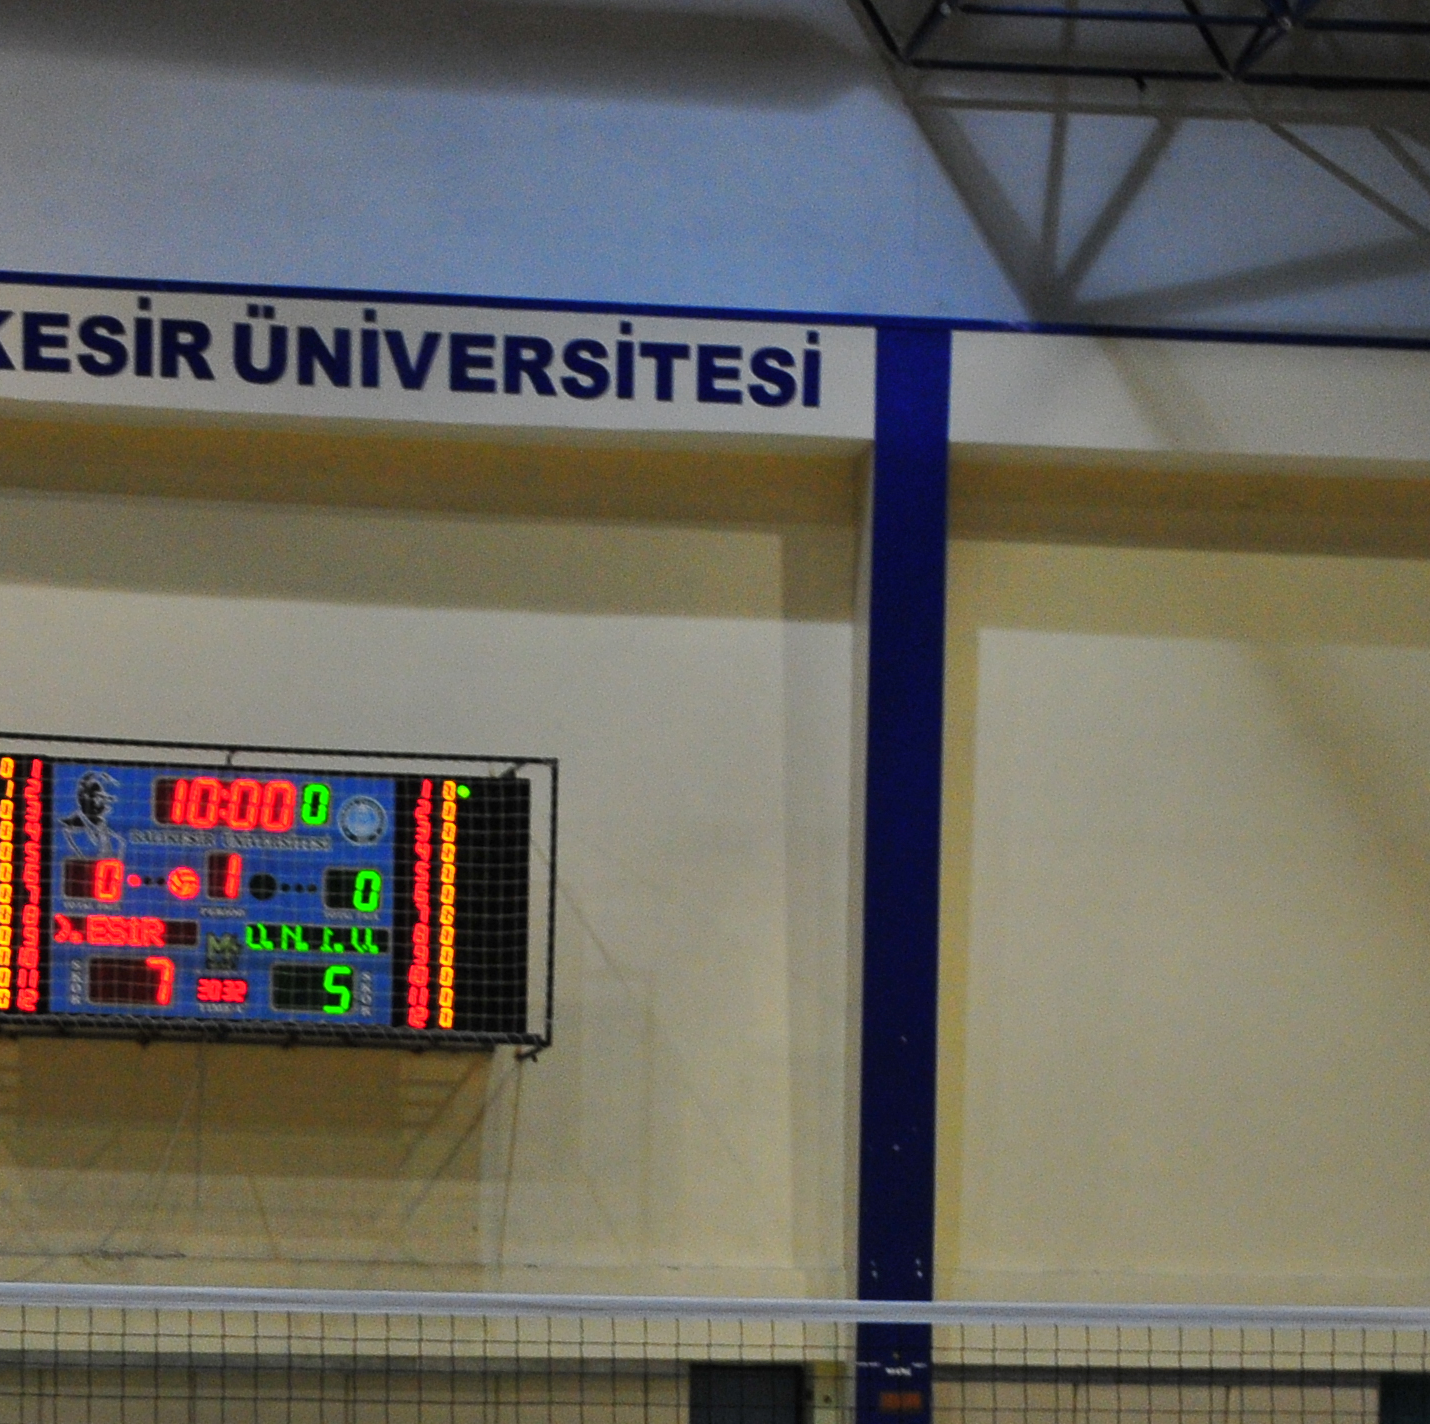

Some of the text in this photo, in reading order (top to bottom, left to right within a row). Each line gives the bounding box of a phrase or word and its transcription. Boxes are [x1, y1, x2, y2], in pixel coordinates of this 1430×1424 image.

[233, 303, 821, 408] ÜNİVERSİTESİ
[172, 776, 330, 832] 10:00 0
[93, 853, 382, 912] 0 1 0
[145, 956, 175, 1006] 7
[323, 965, 352, 1014] 5
